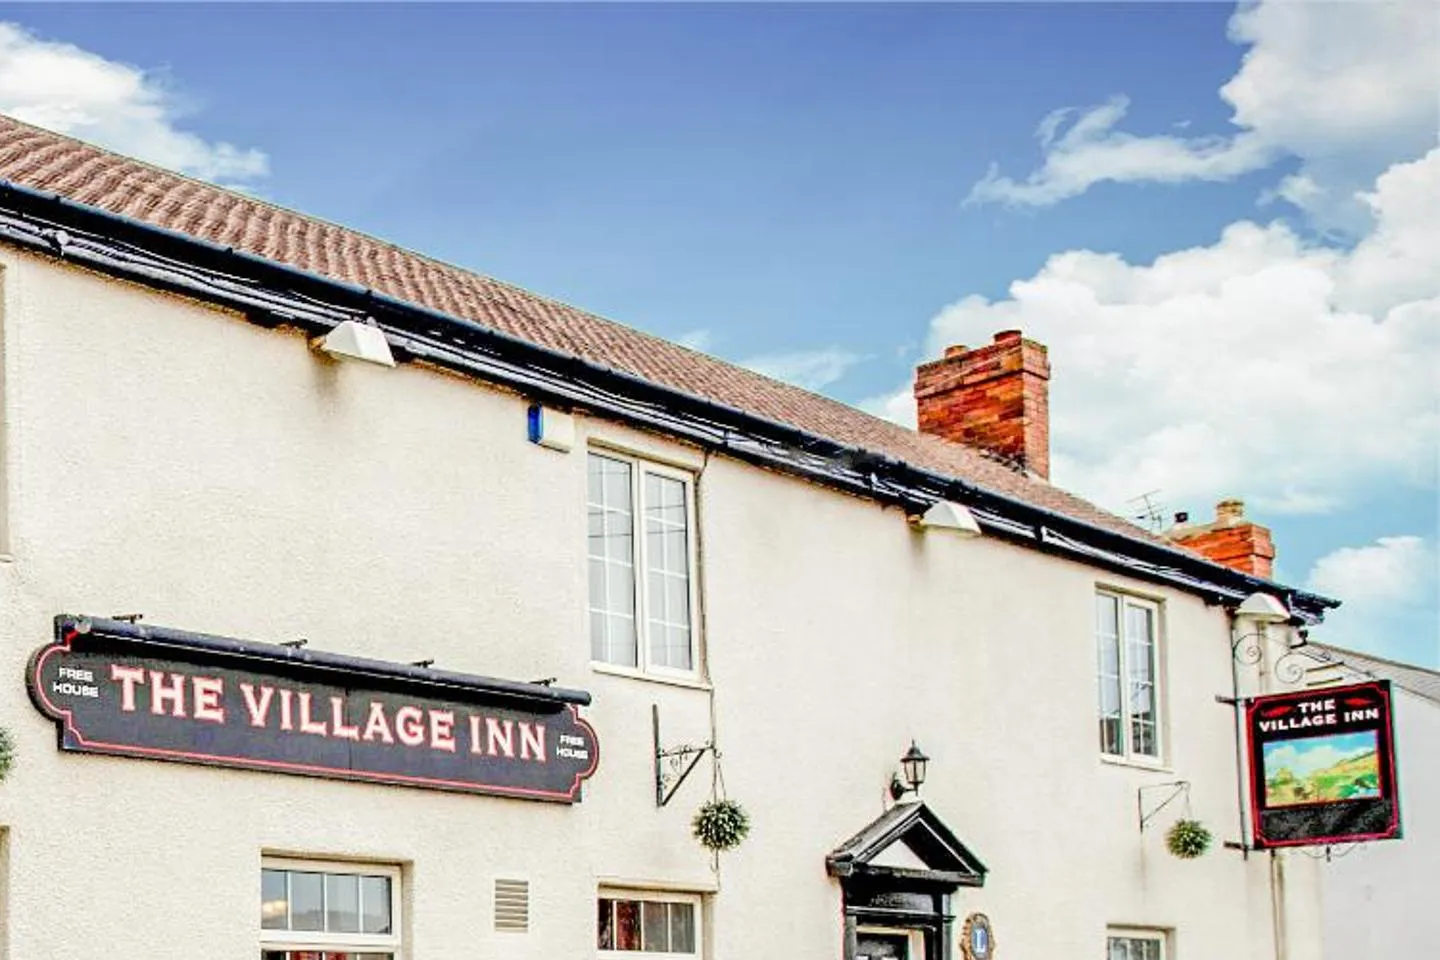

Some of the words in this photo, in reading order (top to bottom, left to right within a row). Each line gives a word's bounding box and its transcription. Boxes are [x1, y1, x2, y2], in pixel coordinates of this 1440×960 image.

[59, 667, 93, 682] FREE
[53, 682, 99, 697] HOUSE
[111, 664, 225, 724] THE
[239, 682, 456, 753] VILLAGE
[469, 715, 546, 762] INN
[1298, 699, 1336, 713] THE
[1259, 714, 1337, 732] VILLAGE
[1344, 708, 1379, 722] INN
